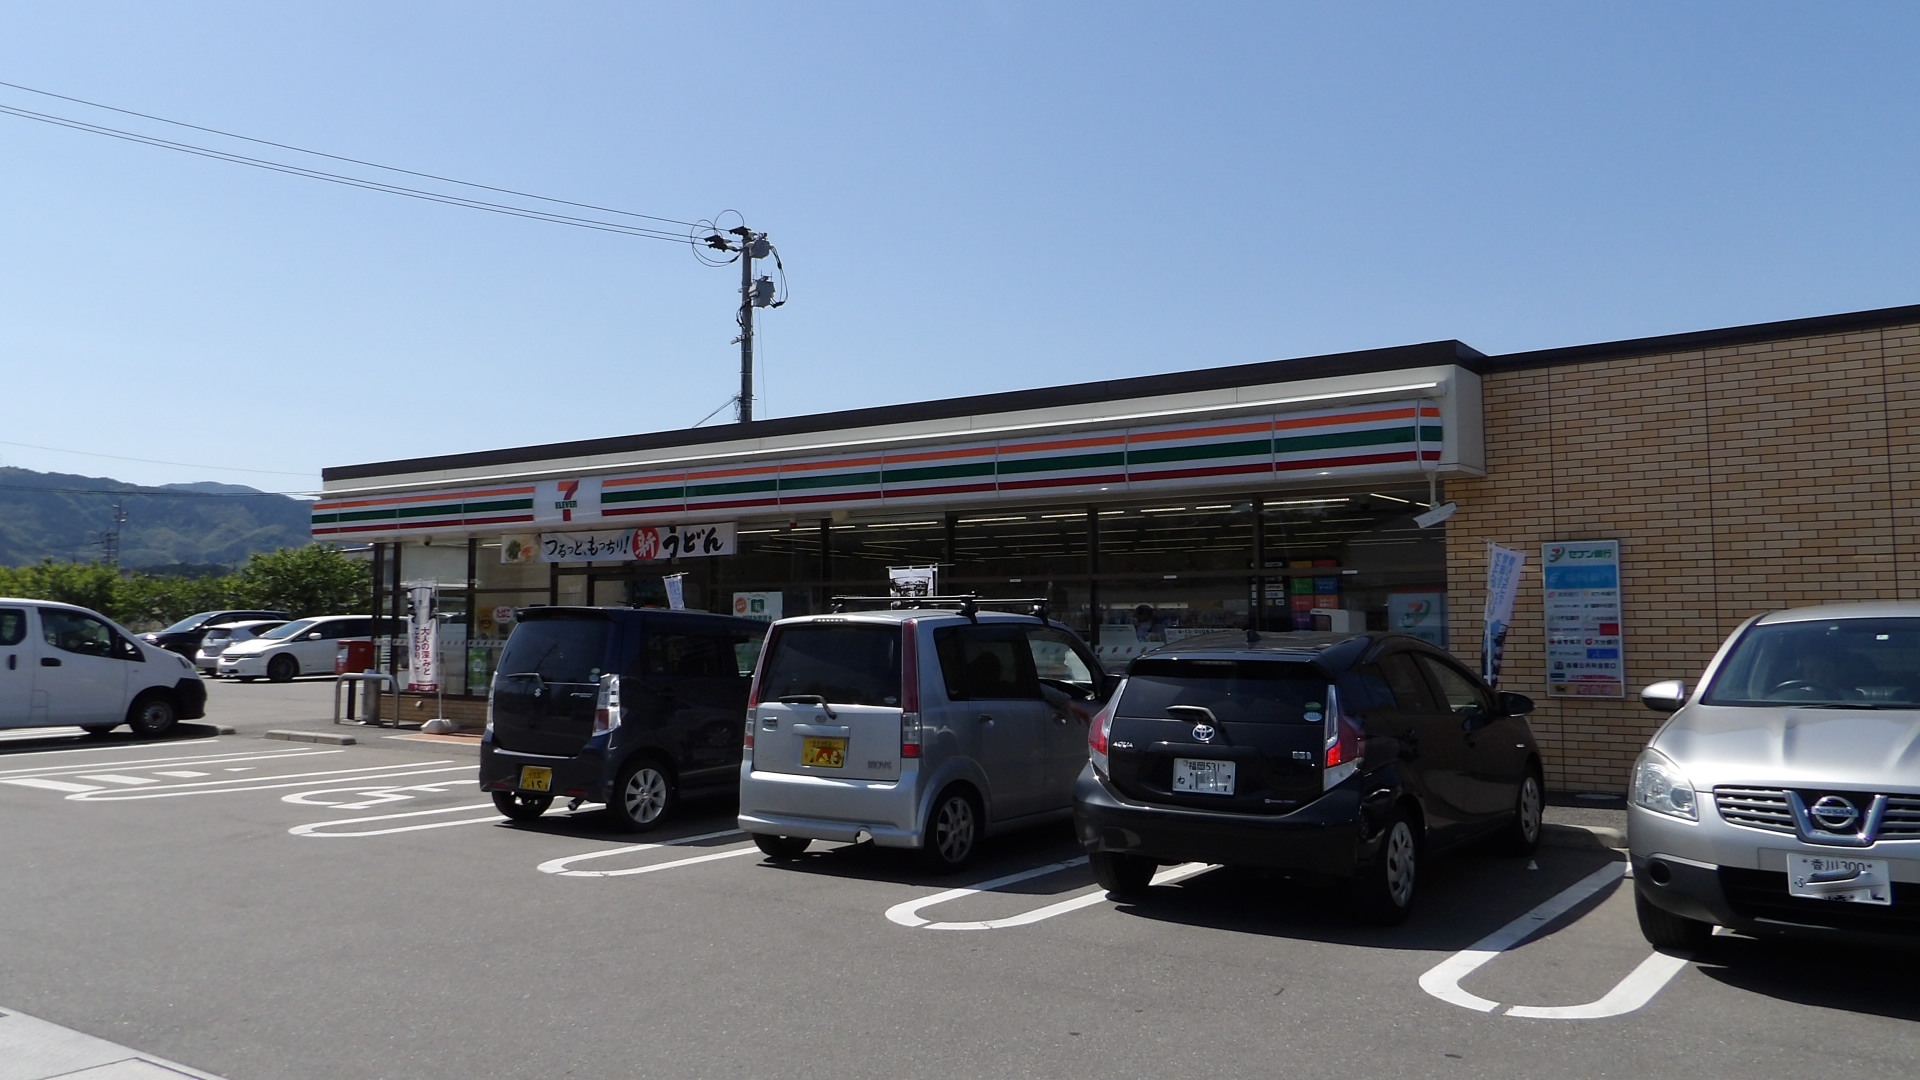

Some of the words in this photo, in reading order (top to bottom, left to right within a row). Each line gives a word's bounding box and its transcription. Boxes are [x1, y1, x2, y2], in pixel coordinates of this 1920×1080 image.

[557, 480, 579, 521] 7
[635, 529, 655, 558] 新
[663, 526, 723, 558] うどん
[1568, 549, 1612, 559] セブン銀行
[421, 627, 431, 675] 大人の深みと
